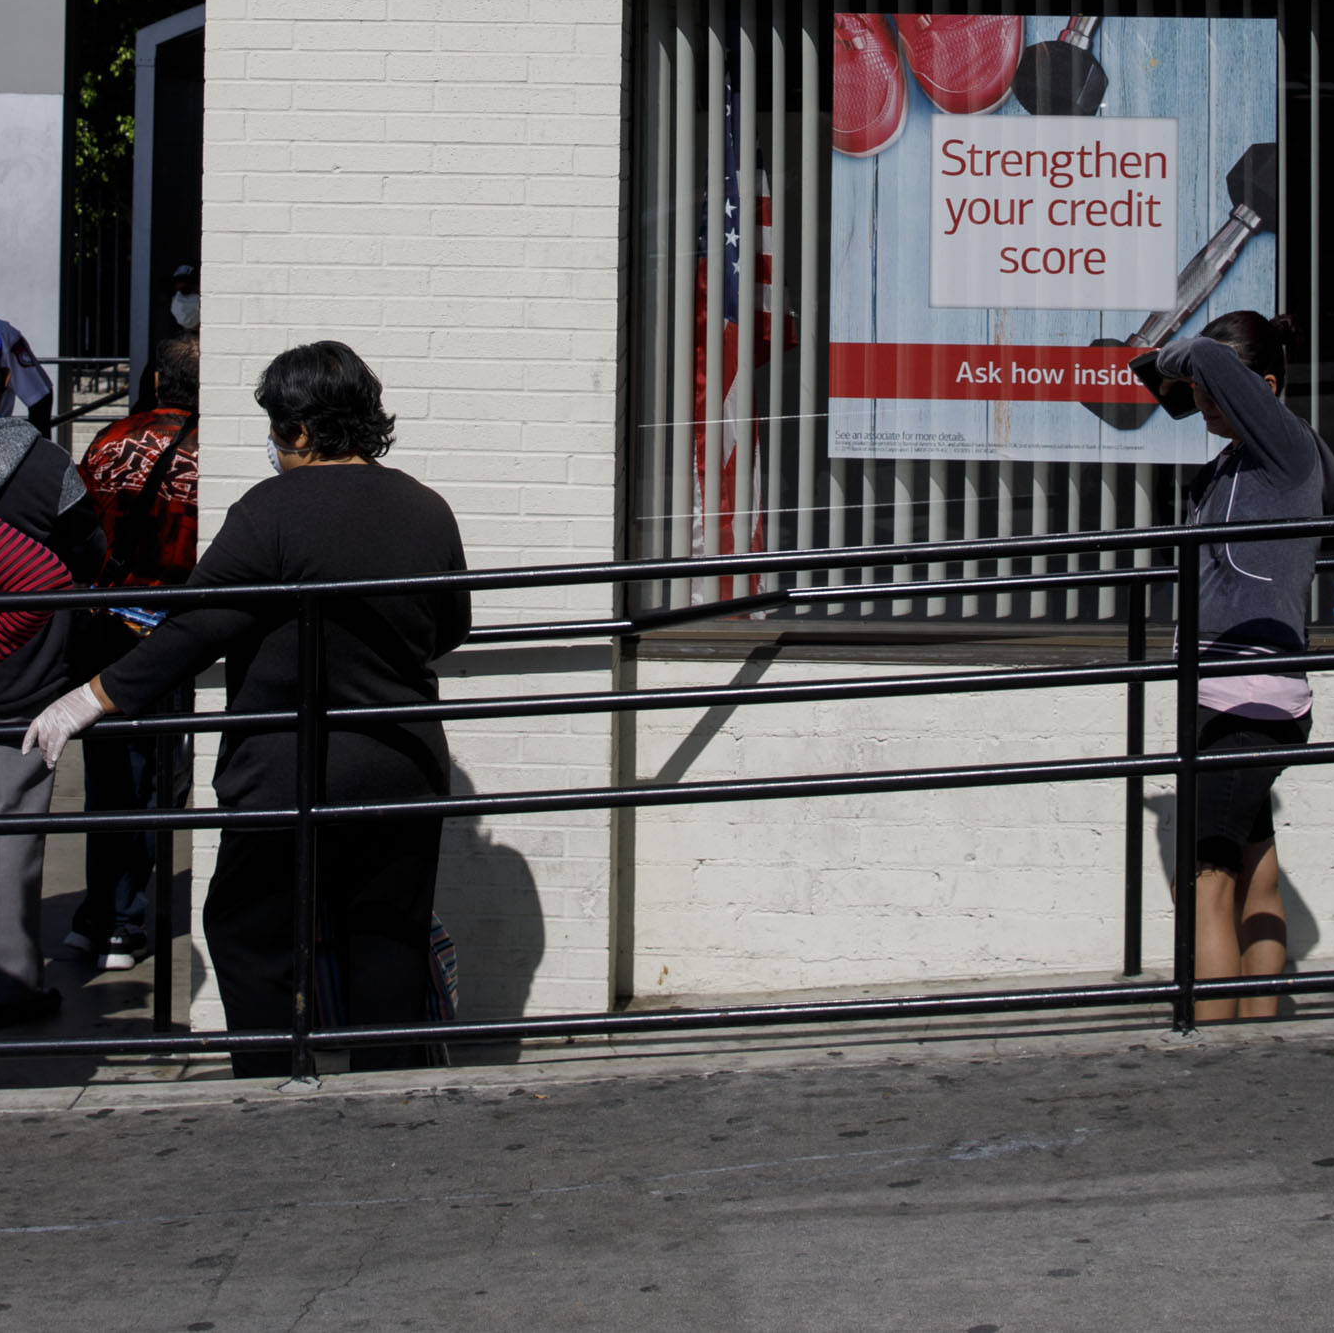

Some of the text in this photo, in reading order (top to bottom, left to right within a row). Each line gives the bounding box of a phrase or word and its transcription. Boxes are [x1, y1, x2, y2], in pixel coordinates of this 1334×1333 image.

[941, 138, 1167, 188] Strengthen
[944, 189, 1162, 235] your credit
[999, 246, 1106, 275] score
[955, 361, 1003, 384] Ask
[1011, 361, 1065, 385] how
[834, 430, 851, 441] See
[852, 432, 862, 441] an
[902, 431, 914, 441] for
[915, 433, 937, 441] more
